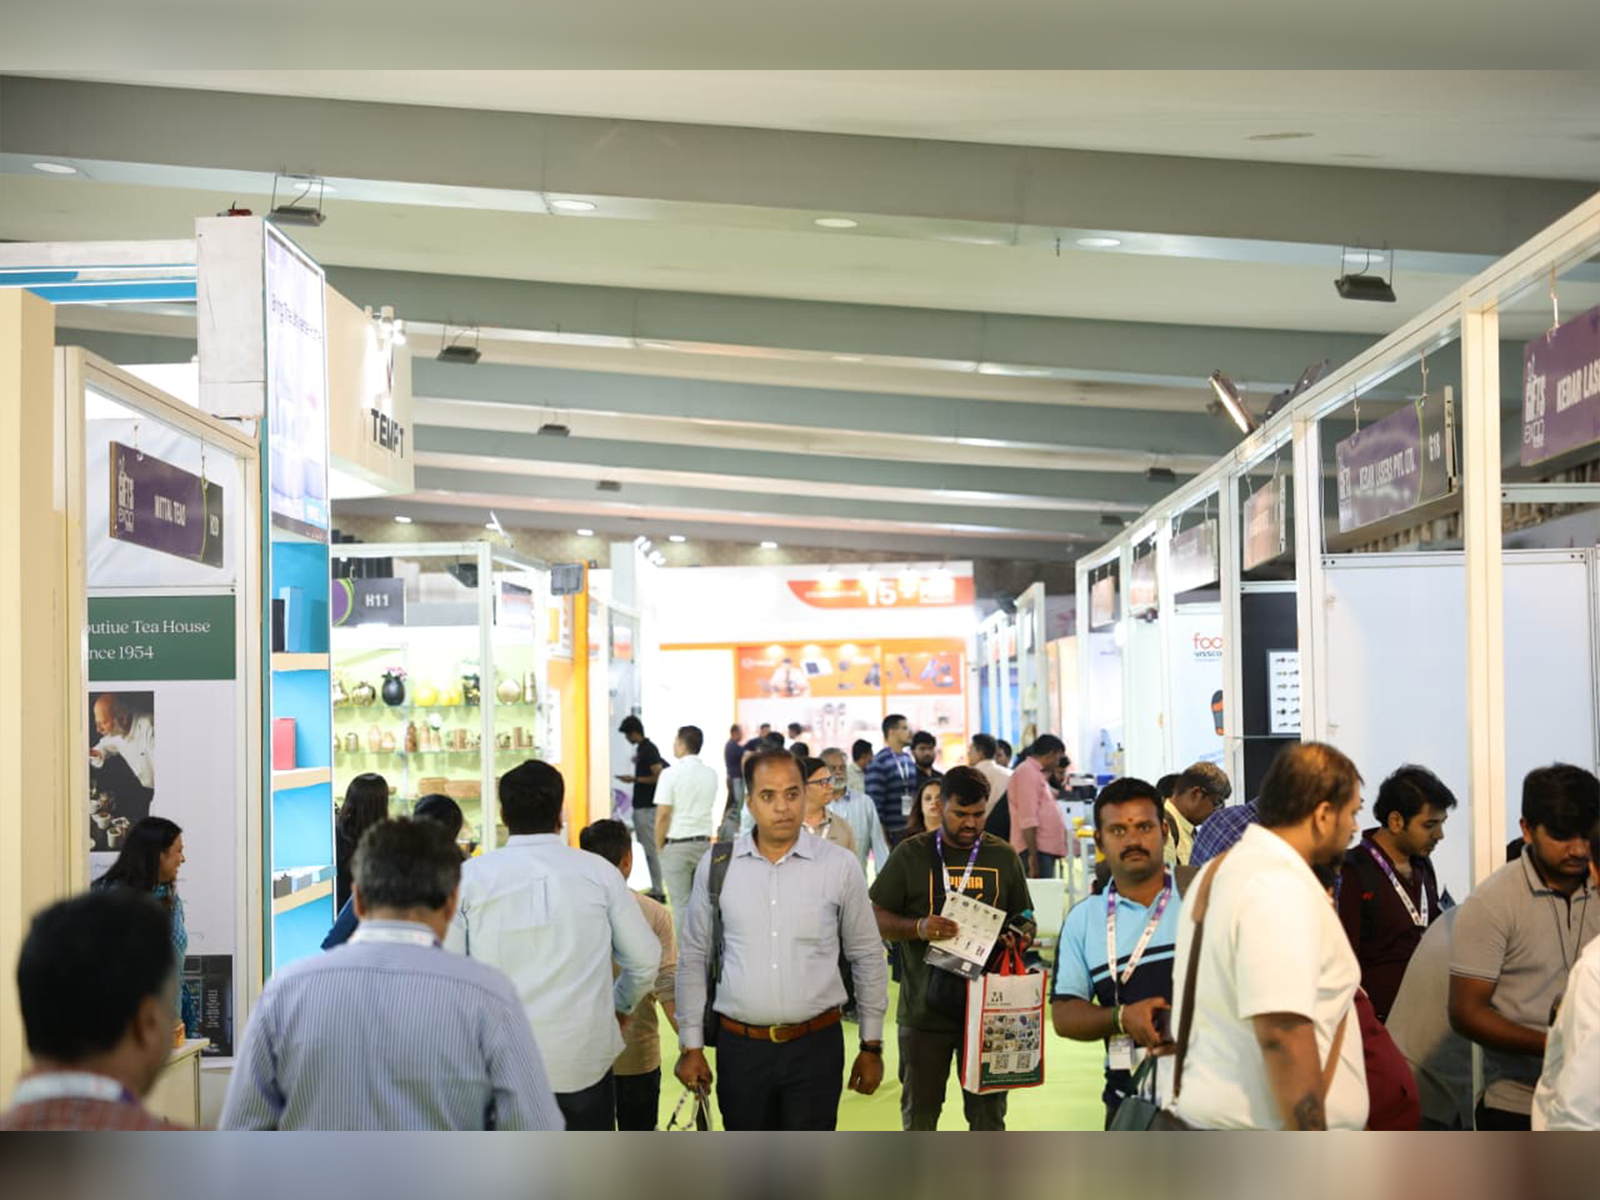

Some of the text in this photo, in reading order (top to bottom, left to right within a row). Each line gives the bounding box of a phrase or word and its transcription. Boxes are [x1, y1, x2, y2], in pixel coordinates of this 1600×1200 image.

[365, 593, 389, 607] H11
[132, 620, 160, 634] Tea
[163, 619, 211, 634] House
[119, 645, 154, 660] 1954
